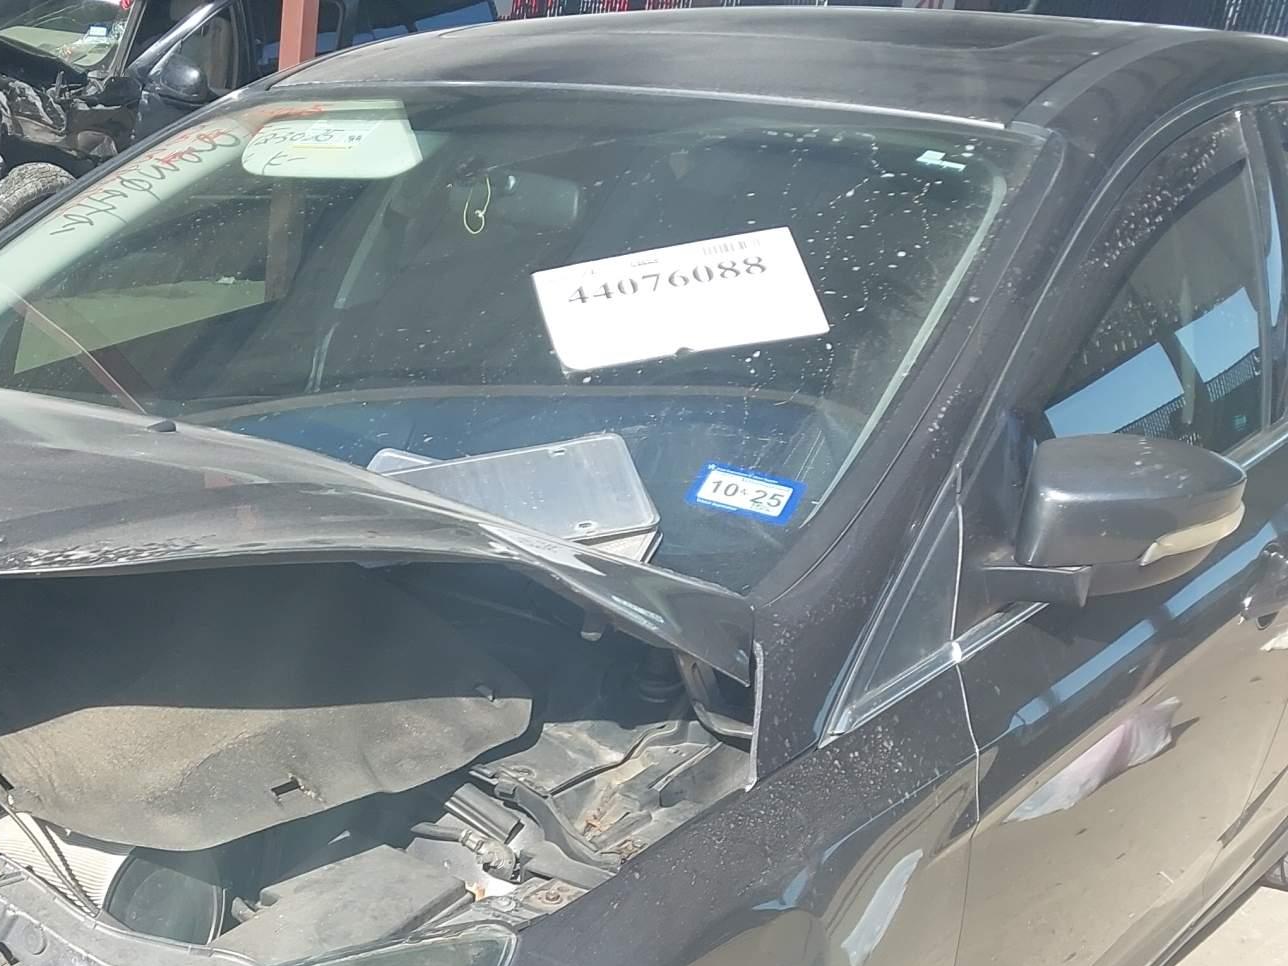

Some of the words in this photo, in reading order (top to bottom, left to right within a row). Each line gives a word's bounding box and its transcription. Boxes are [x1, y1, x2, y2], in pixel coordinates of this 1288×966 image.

[568, 256, 767, 303] 44076088
[712, 480, 740, 497] 10
[749, 489, 785, 508] 25
